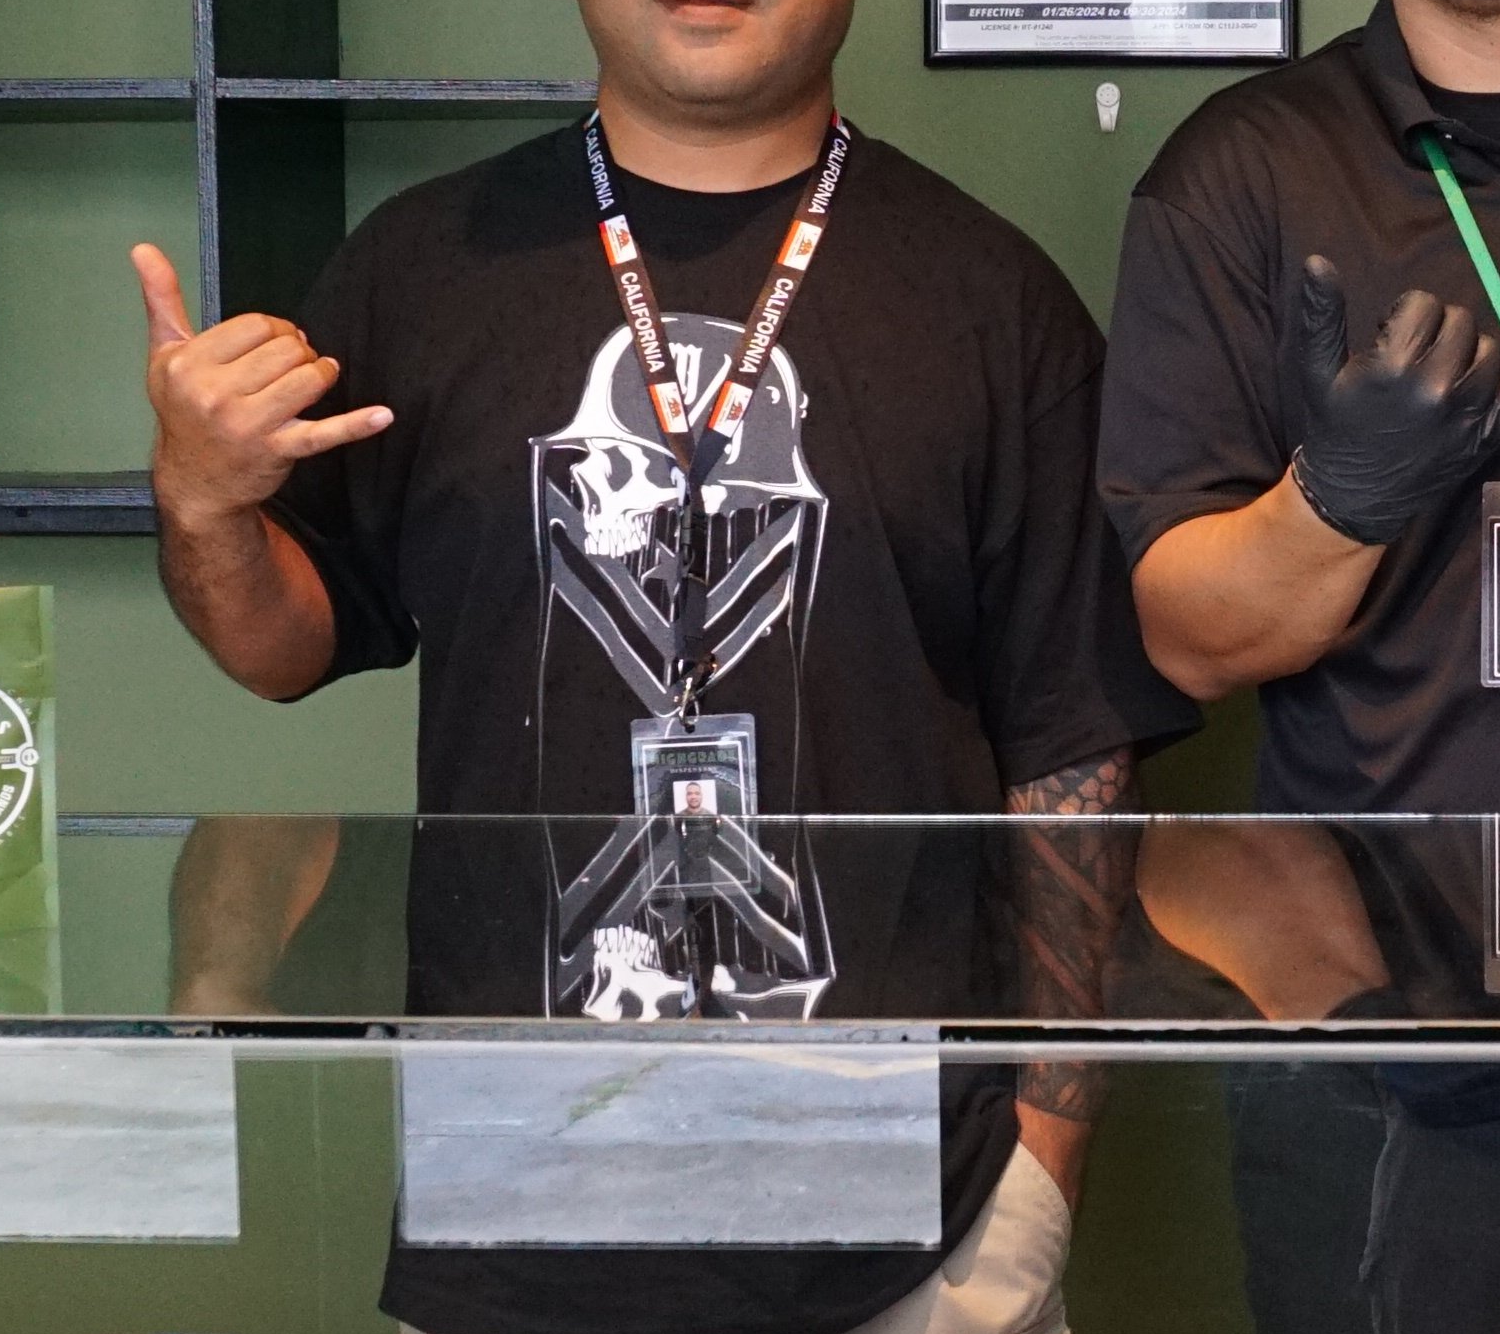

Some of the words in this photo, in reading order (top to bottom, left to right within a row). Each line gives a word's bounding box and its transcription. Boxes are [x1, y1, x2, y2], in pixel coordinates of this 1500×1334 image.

[968, 7, 1024, 18] EFFECTIVE:
[1042, 6, 1106, 17] 01/26/2024
[1108, 7, 1120, 17] to
[585, 127, 615, 212] CALIFORNIA
[807, 137, 848, 215] CALIFORNIA
[620, 271, 666, 374] CALIFORNIA
[738, 277, 794, 374] CALIFORNIA
